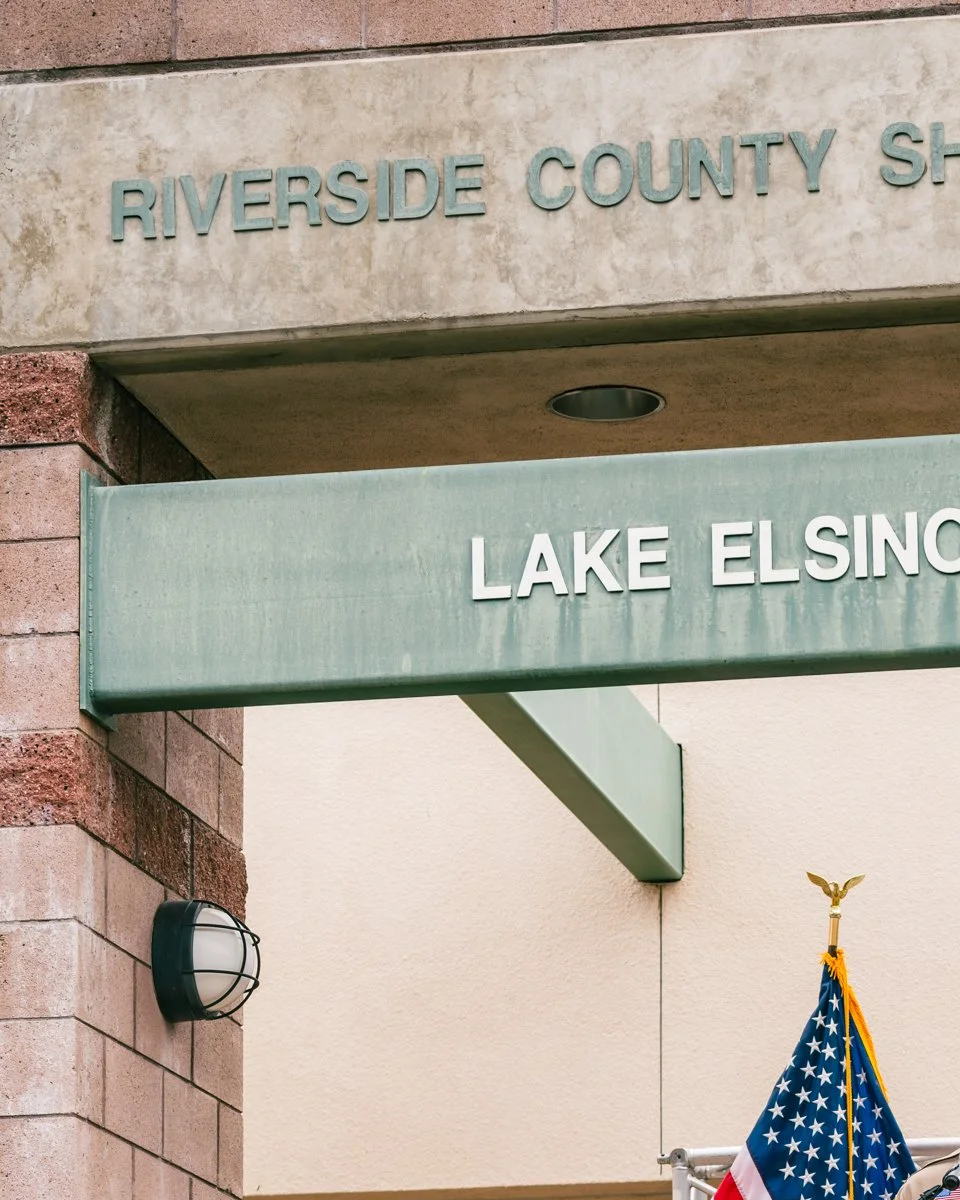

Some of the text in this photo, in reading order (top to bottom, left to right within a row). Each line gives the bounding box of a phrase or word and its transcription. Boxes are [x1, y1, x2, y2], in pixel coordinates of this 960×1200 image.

[111, 154, 485, 242] RIVERSIDE
[526, 128, 837, 211] COUNTY
[470, 525, 672, 602] LAKE
